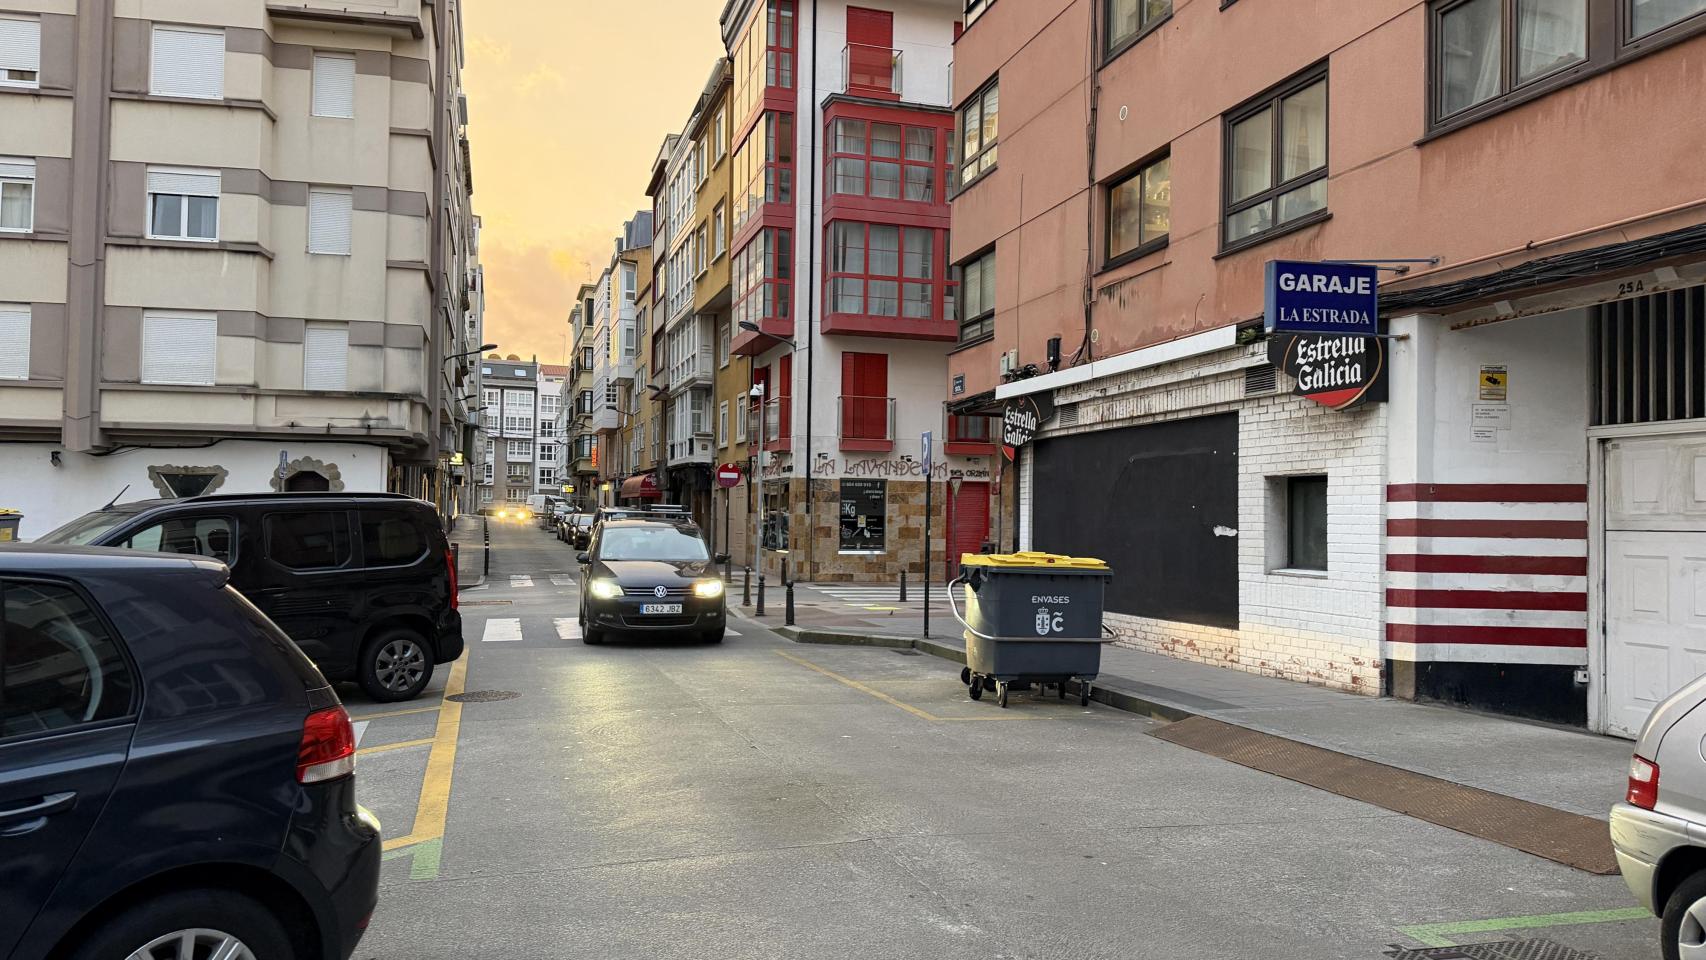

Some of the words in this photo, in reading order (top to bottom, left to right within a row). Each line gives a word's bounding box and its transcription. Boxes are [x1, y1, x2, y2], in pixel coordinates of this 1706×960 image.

[1279, 273, 1371, 294] GARAJE
[1280, 307, 1300, 322] LA
[1303, 308, 1370, 325] ESTRADA
[1295, 336, 1366, 365] Estrella
[1298, 358, 1362, 391] Galicia
[1004, 405, 1036, 431] Estrella
[812, 458, 836, 476] LA
[843, 458, 948, 477] LAVANDEIA
[1031, 595, 1070, 603] ENVASES
